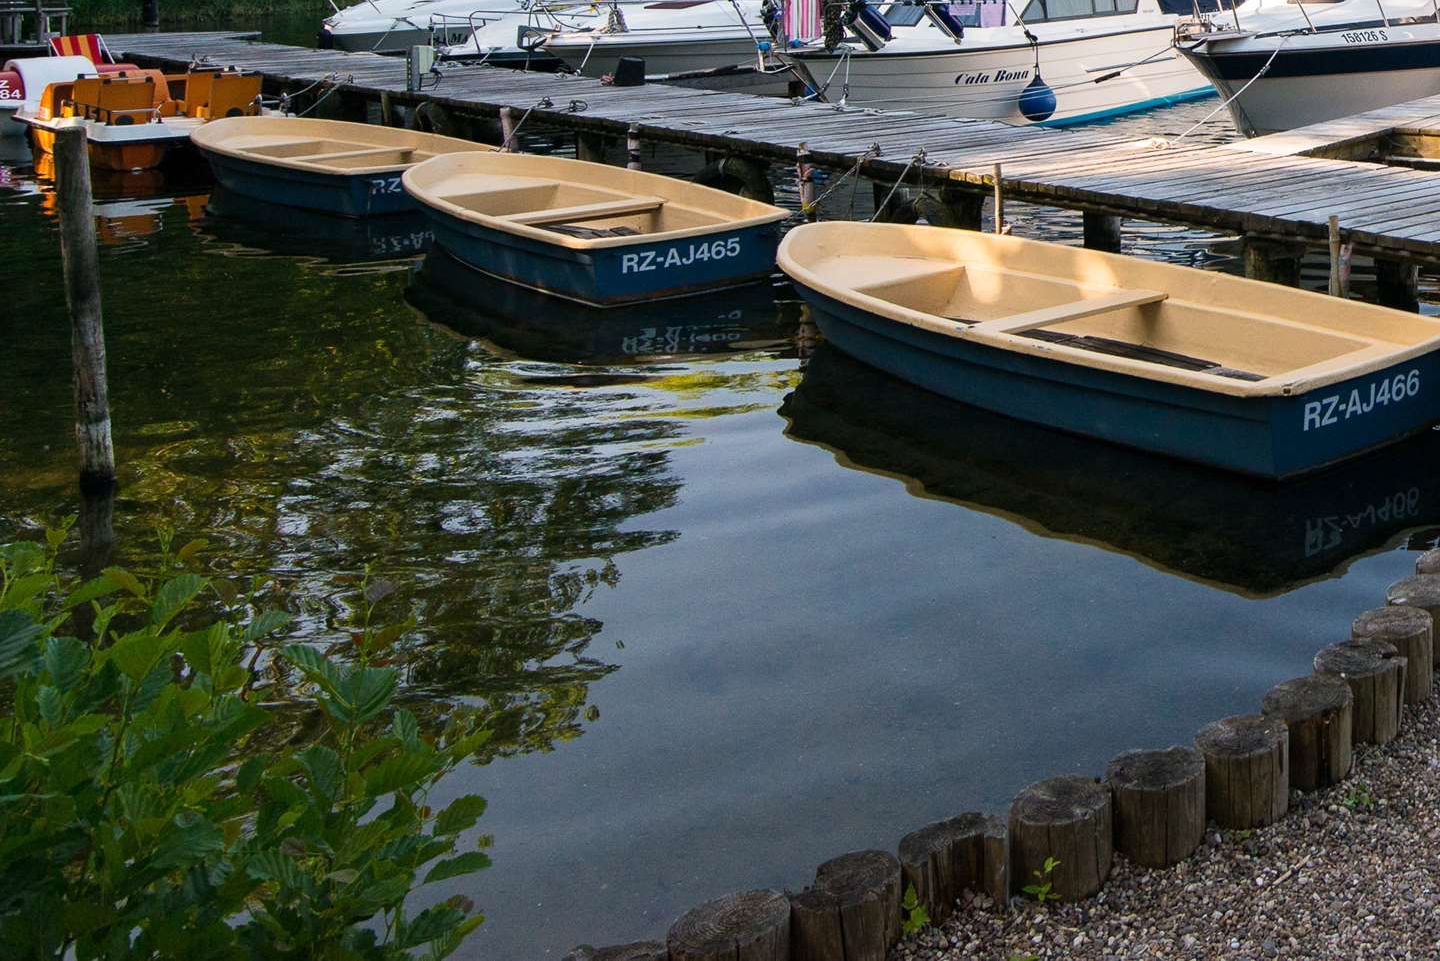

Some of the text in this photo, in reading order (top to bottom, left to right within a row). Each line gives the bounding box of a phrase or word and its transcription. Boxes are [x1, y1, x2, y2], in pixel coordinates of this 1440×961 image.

[1341, 30, 1388, 44] 158126 S
[954, 70, 1029, 85] Cala Bona
[622, 237, 741, 274] RZ-AJ465
[1303, 369, 1420, 431] RZ-AJ466
